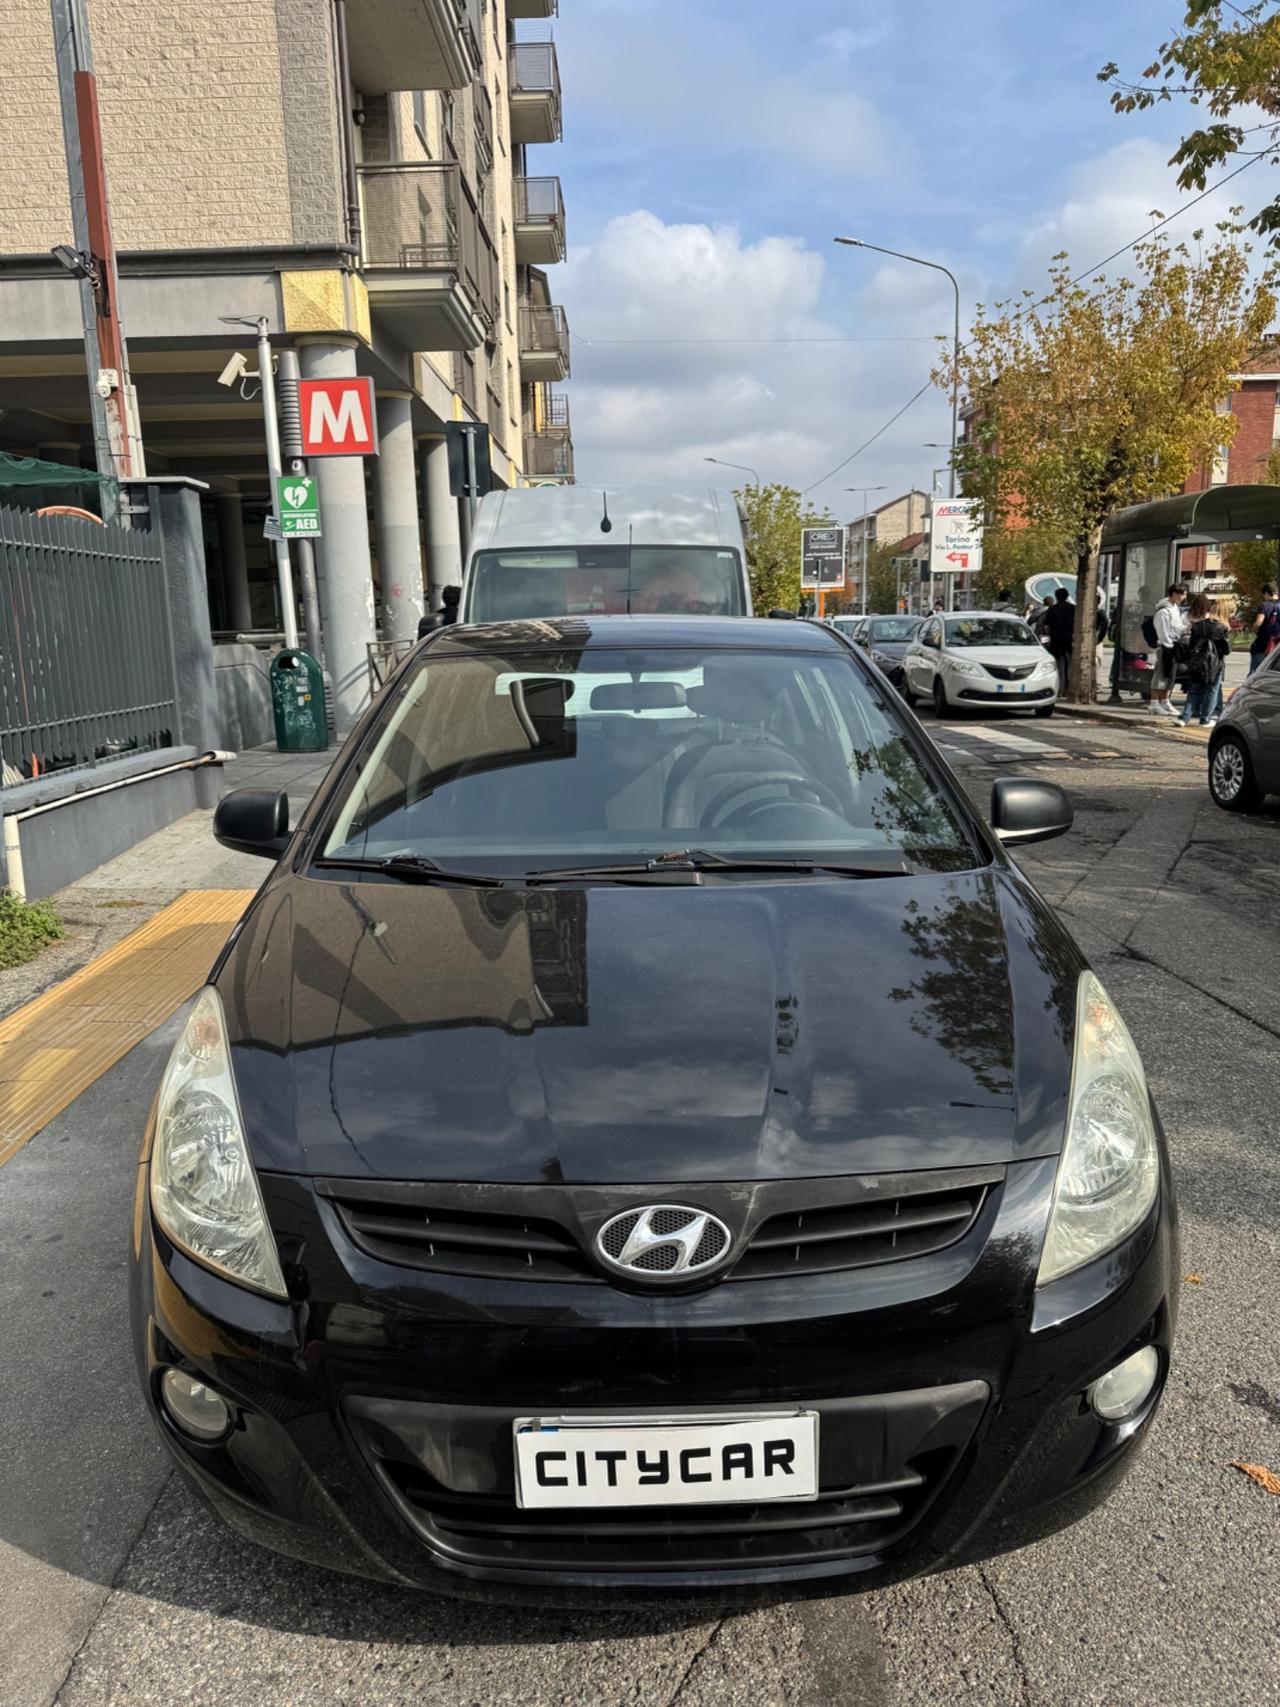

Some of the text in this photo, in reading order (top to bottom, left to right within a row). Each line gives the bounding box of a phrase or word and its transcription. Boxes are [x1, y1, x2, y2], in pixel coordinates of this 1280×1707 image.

[308, 390, 369, 444] M
[296, 518, 318, 530] AED
[944, 535, 970, 544] Torino
[535, 1438, 796, 1487] CITYCAR
